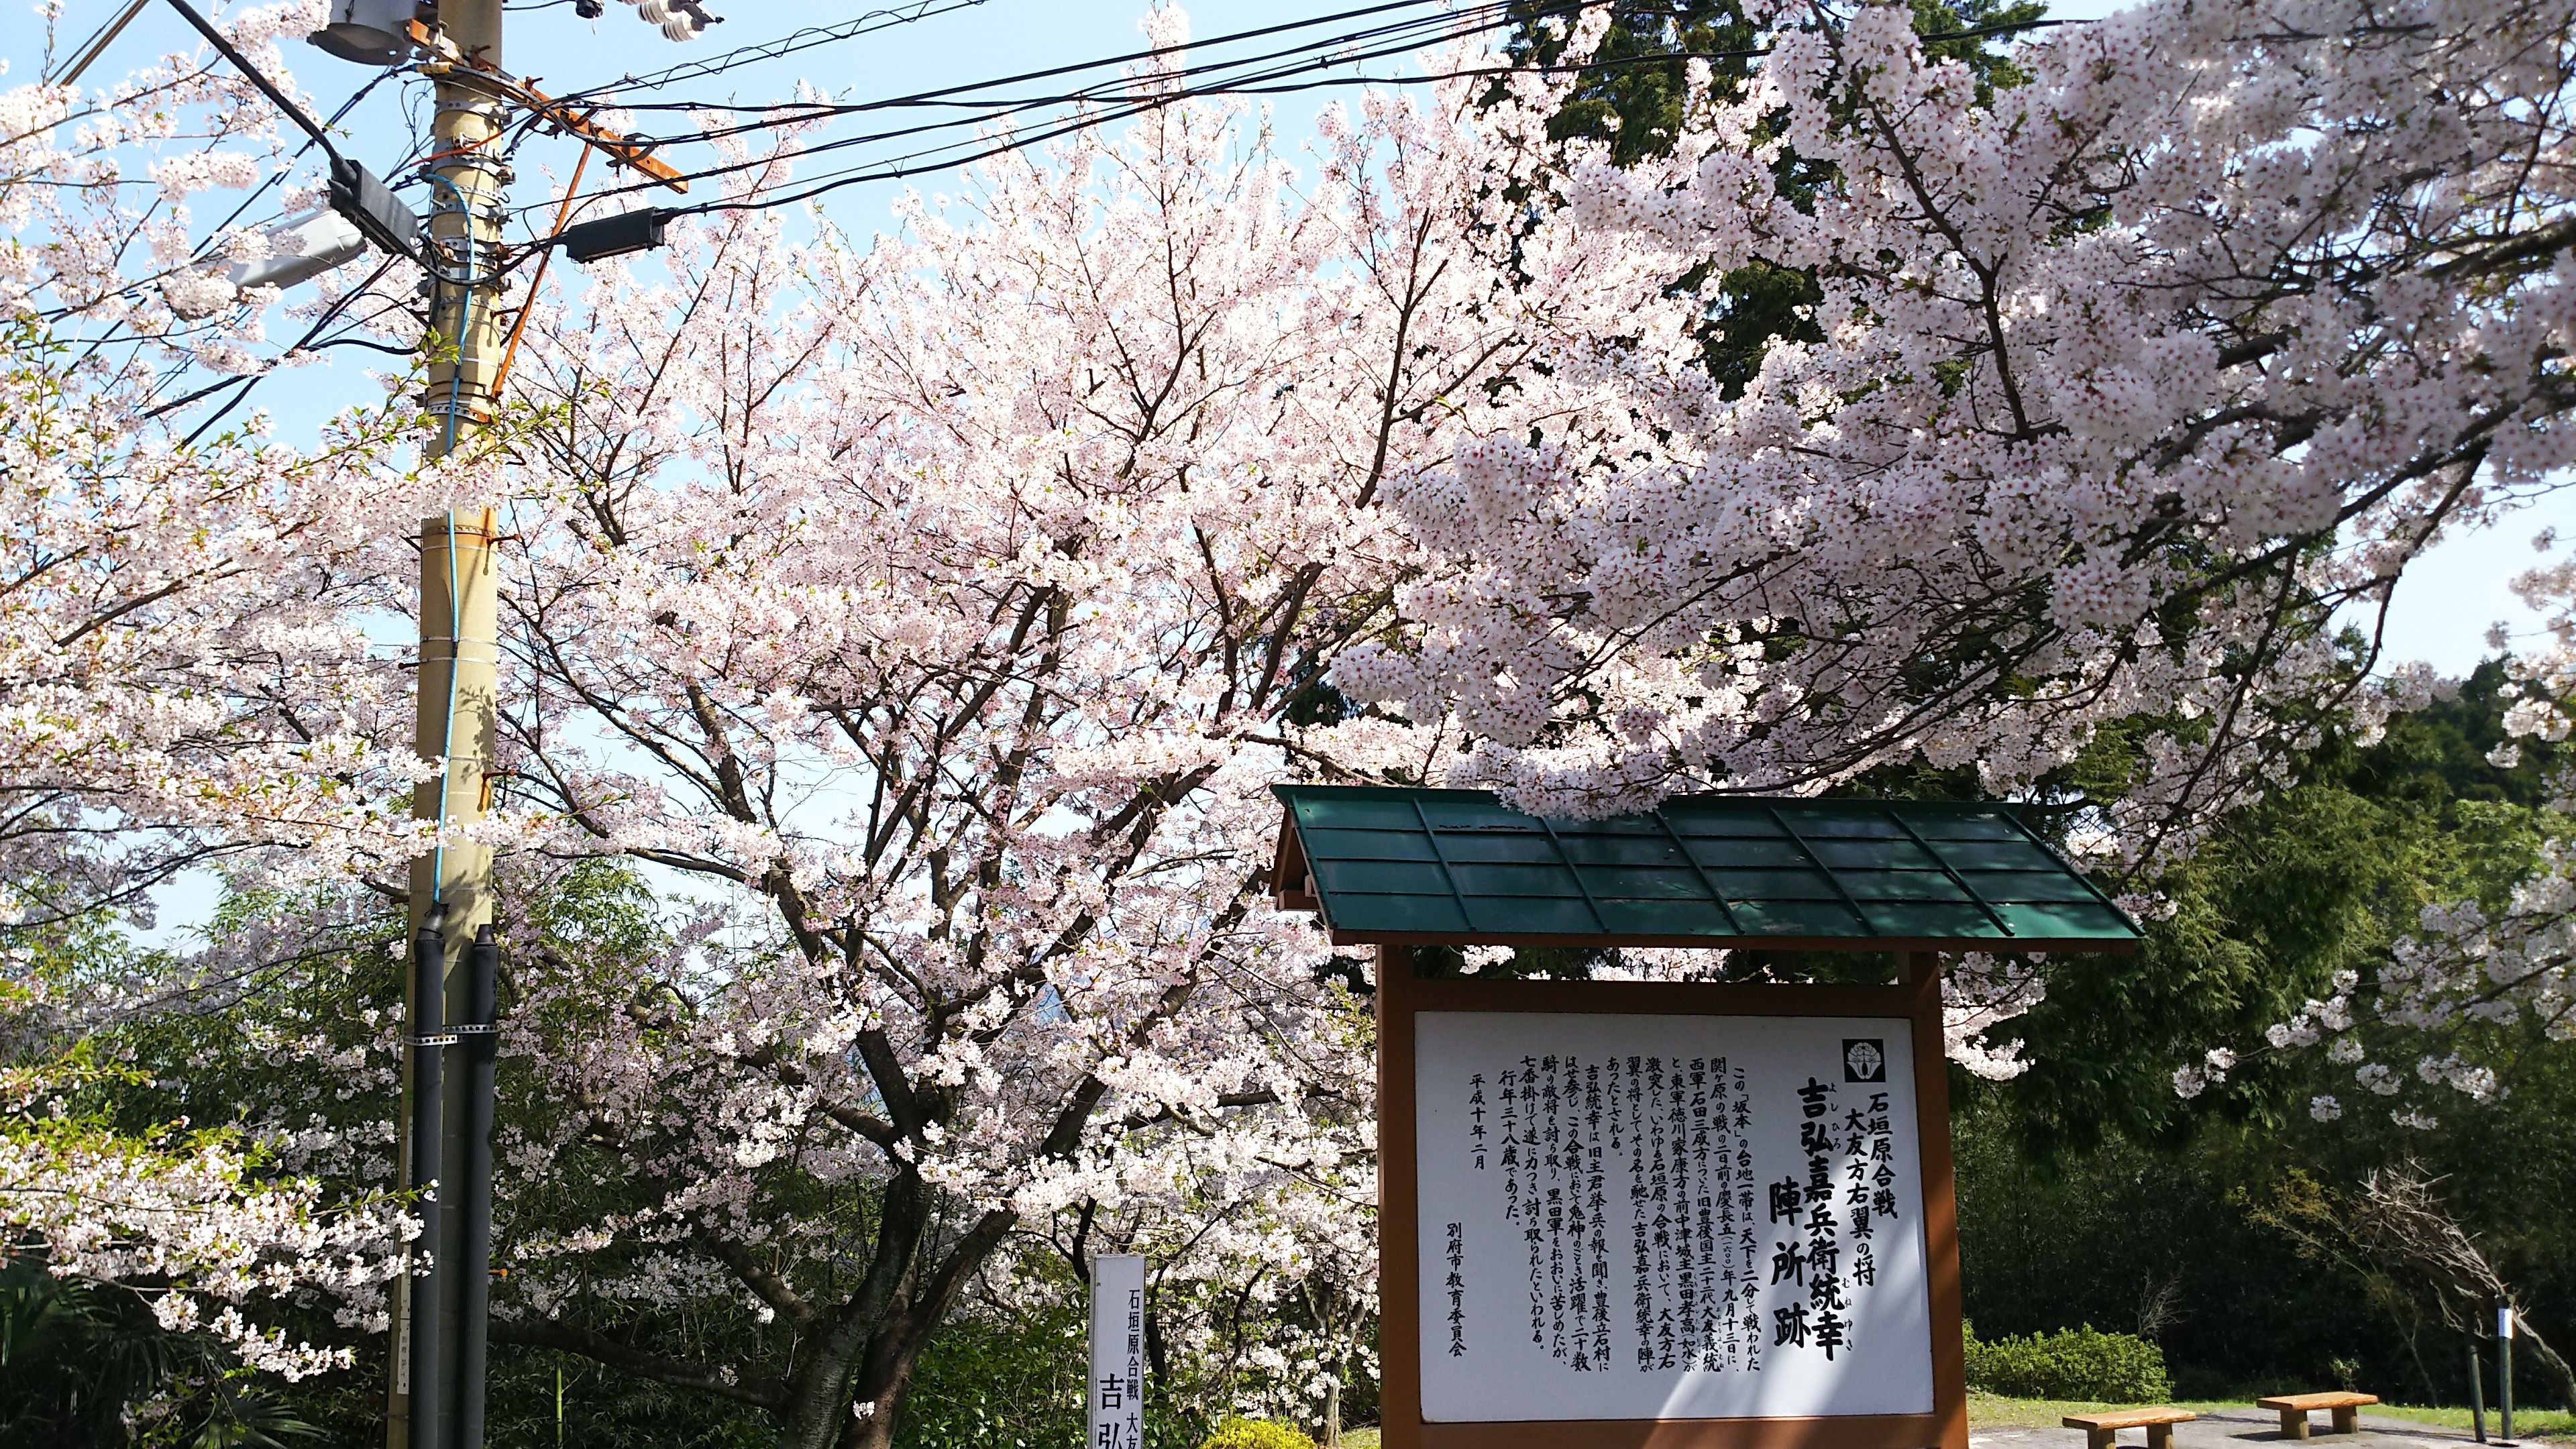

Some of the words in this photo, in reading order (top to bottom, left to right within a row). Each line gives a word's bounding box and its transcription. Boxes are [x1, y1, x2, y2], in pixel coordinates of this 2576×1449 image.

[1469, 1073, 1487, 1170] 平成十年二月
[1498, 1070, 1520, 1226] 行年三十八歳であった。
[1607, 1057, 1624, 1156] あったとされる。
[1829, 1083, 1841, 1149] よしひろ
[1867, 1092, 1898, 1219] 石垣原合戦
[1797, 1077, 1845, 1361] 吉弘嘉兵衛統幸
[1843, 1108, 1876, 1287] 大友方右翼の将
[1446, 1222, 1466, 1357] 別府市教育委員会
[1769, 1175, 1811, 1348] 陣所跡
[1842, 1277, 1852, 1351] むねゆき
[1099, 1373, 1124, 1449] 吉弘
